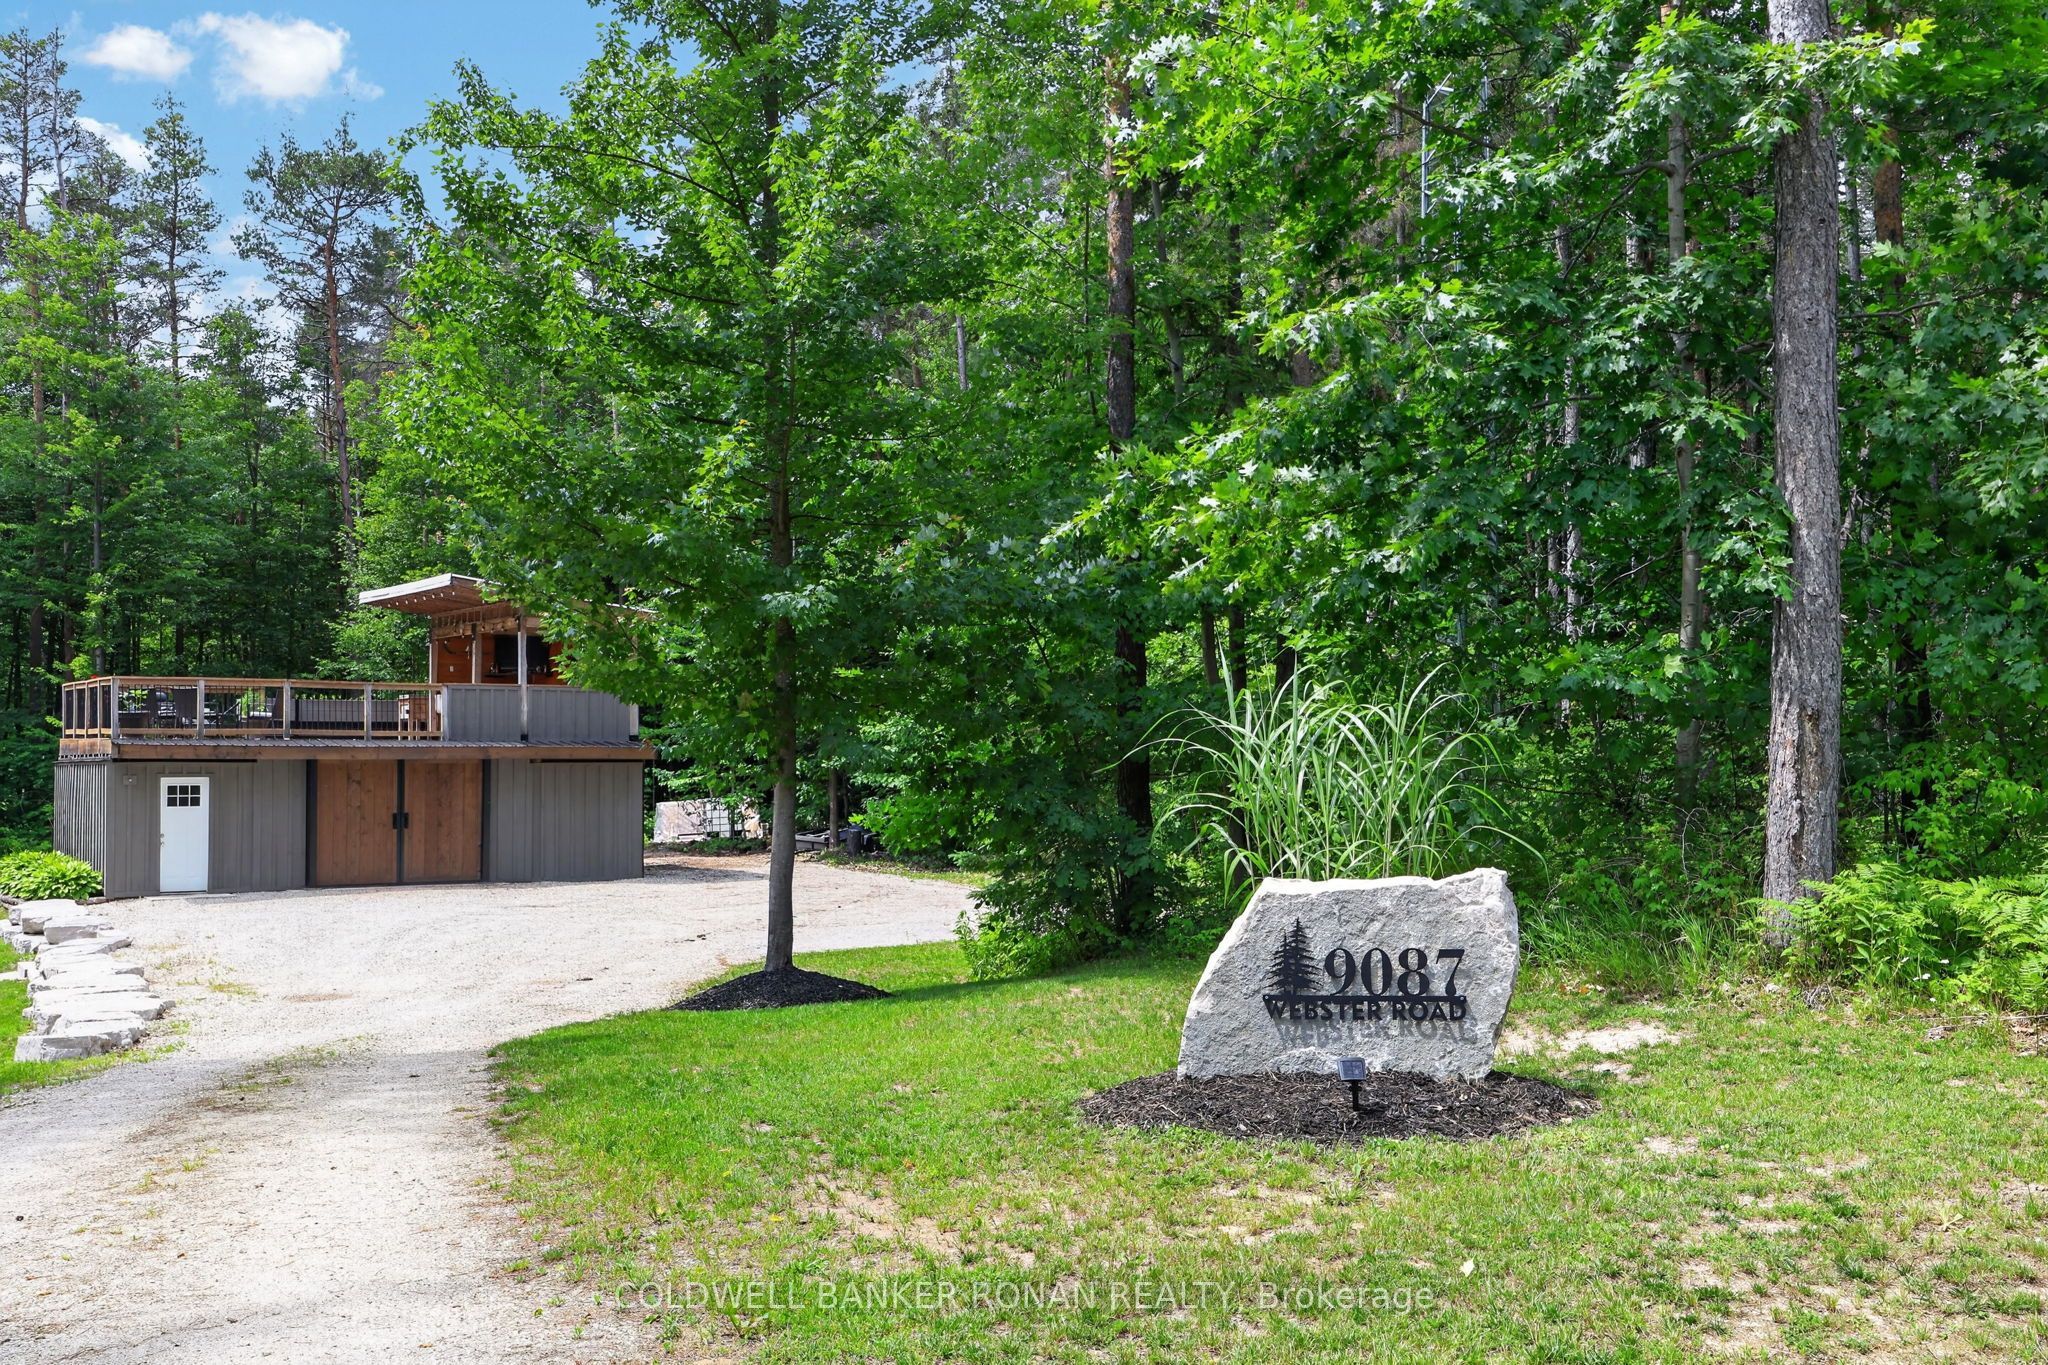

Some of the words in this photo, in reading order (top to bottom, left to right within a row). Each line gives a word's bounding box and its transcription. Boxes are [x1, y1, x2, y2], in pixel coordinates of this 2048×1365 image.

[1324, 947, 1465, 997] 9087
[1267, 1000, 1383, 1021] WEBSTER
[1392, 1000, 1467, 1021] ROAD
